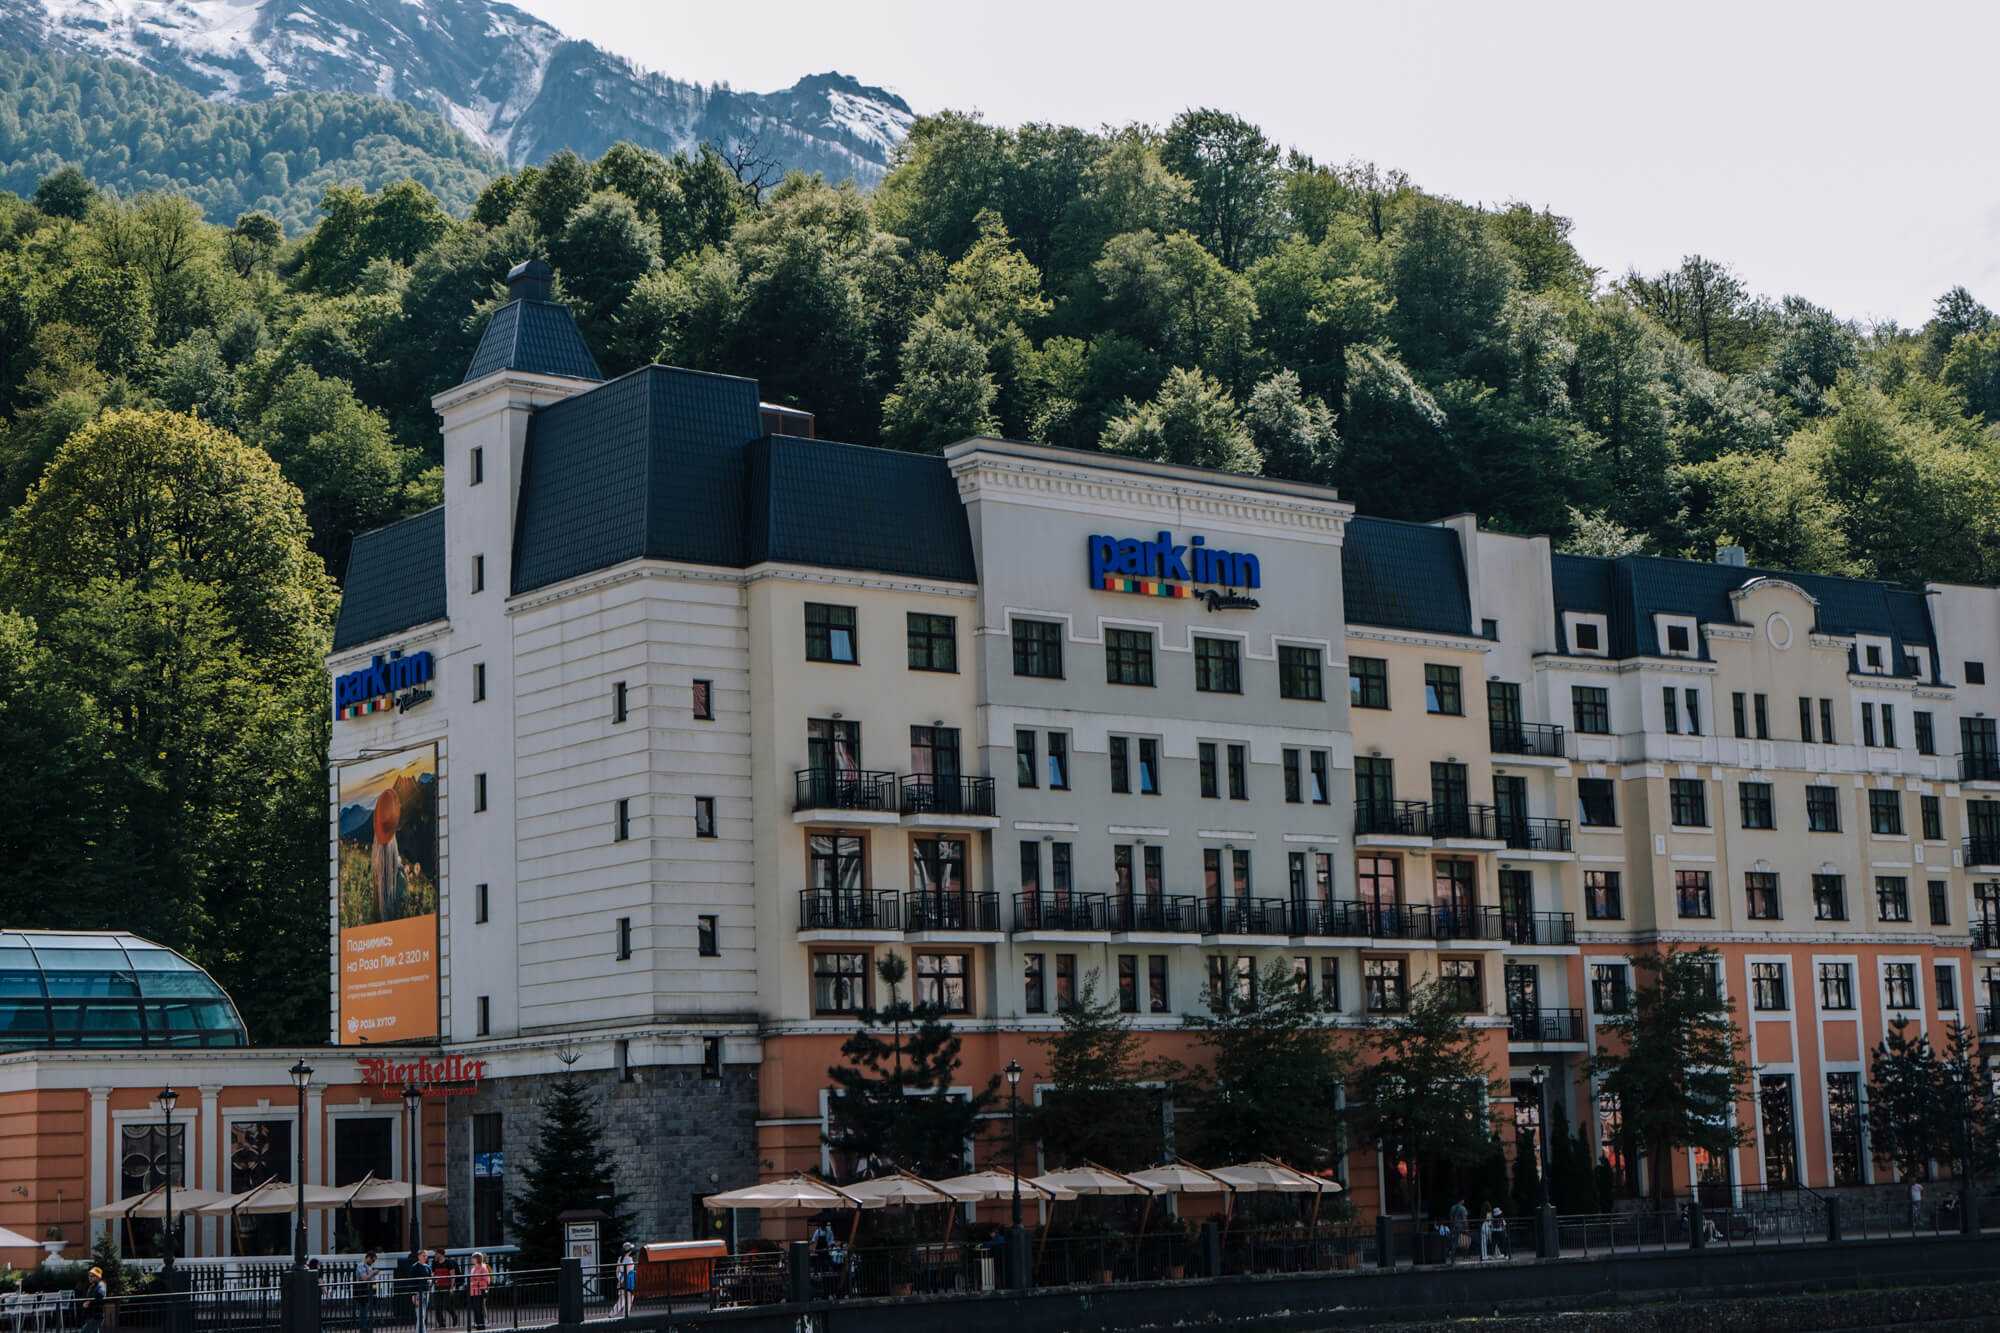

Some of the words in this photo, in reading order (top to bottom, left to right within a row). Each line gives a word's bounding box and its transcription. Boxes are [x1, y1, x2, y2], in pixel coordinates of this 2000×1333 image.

[1088, 531, 1190, 590] park
[1191, 536, 1261, 589] inn
[336, 655, 389, 720] park
[390, 650, 434, 693] inn
[356, 1055, 487, 1084] Bierkeller
